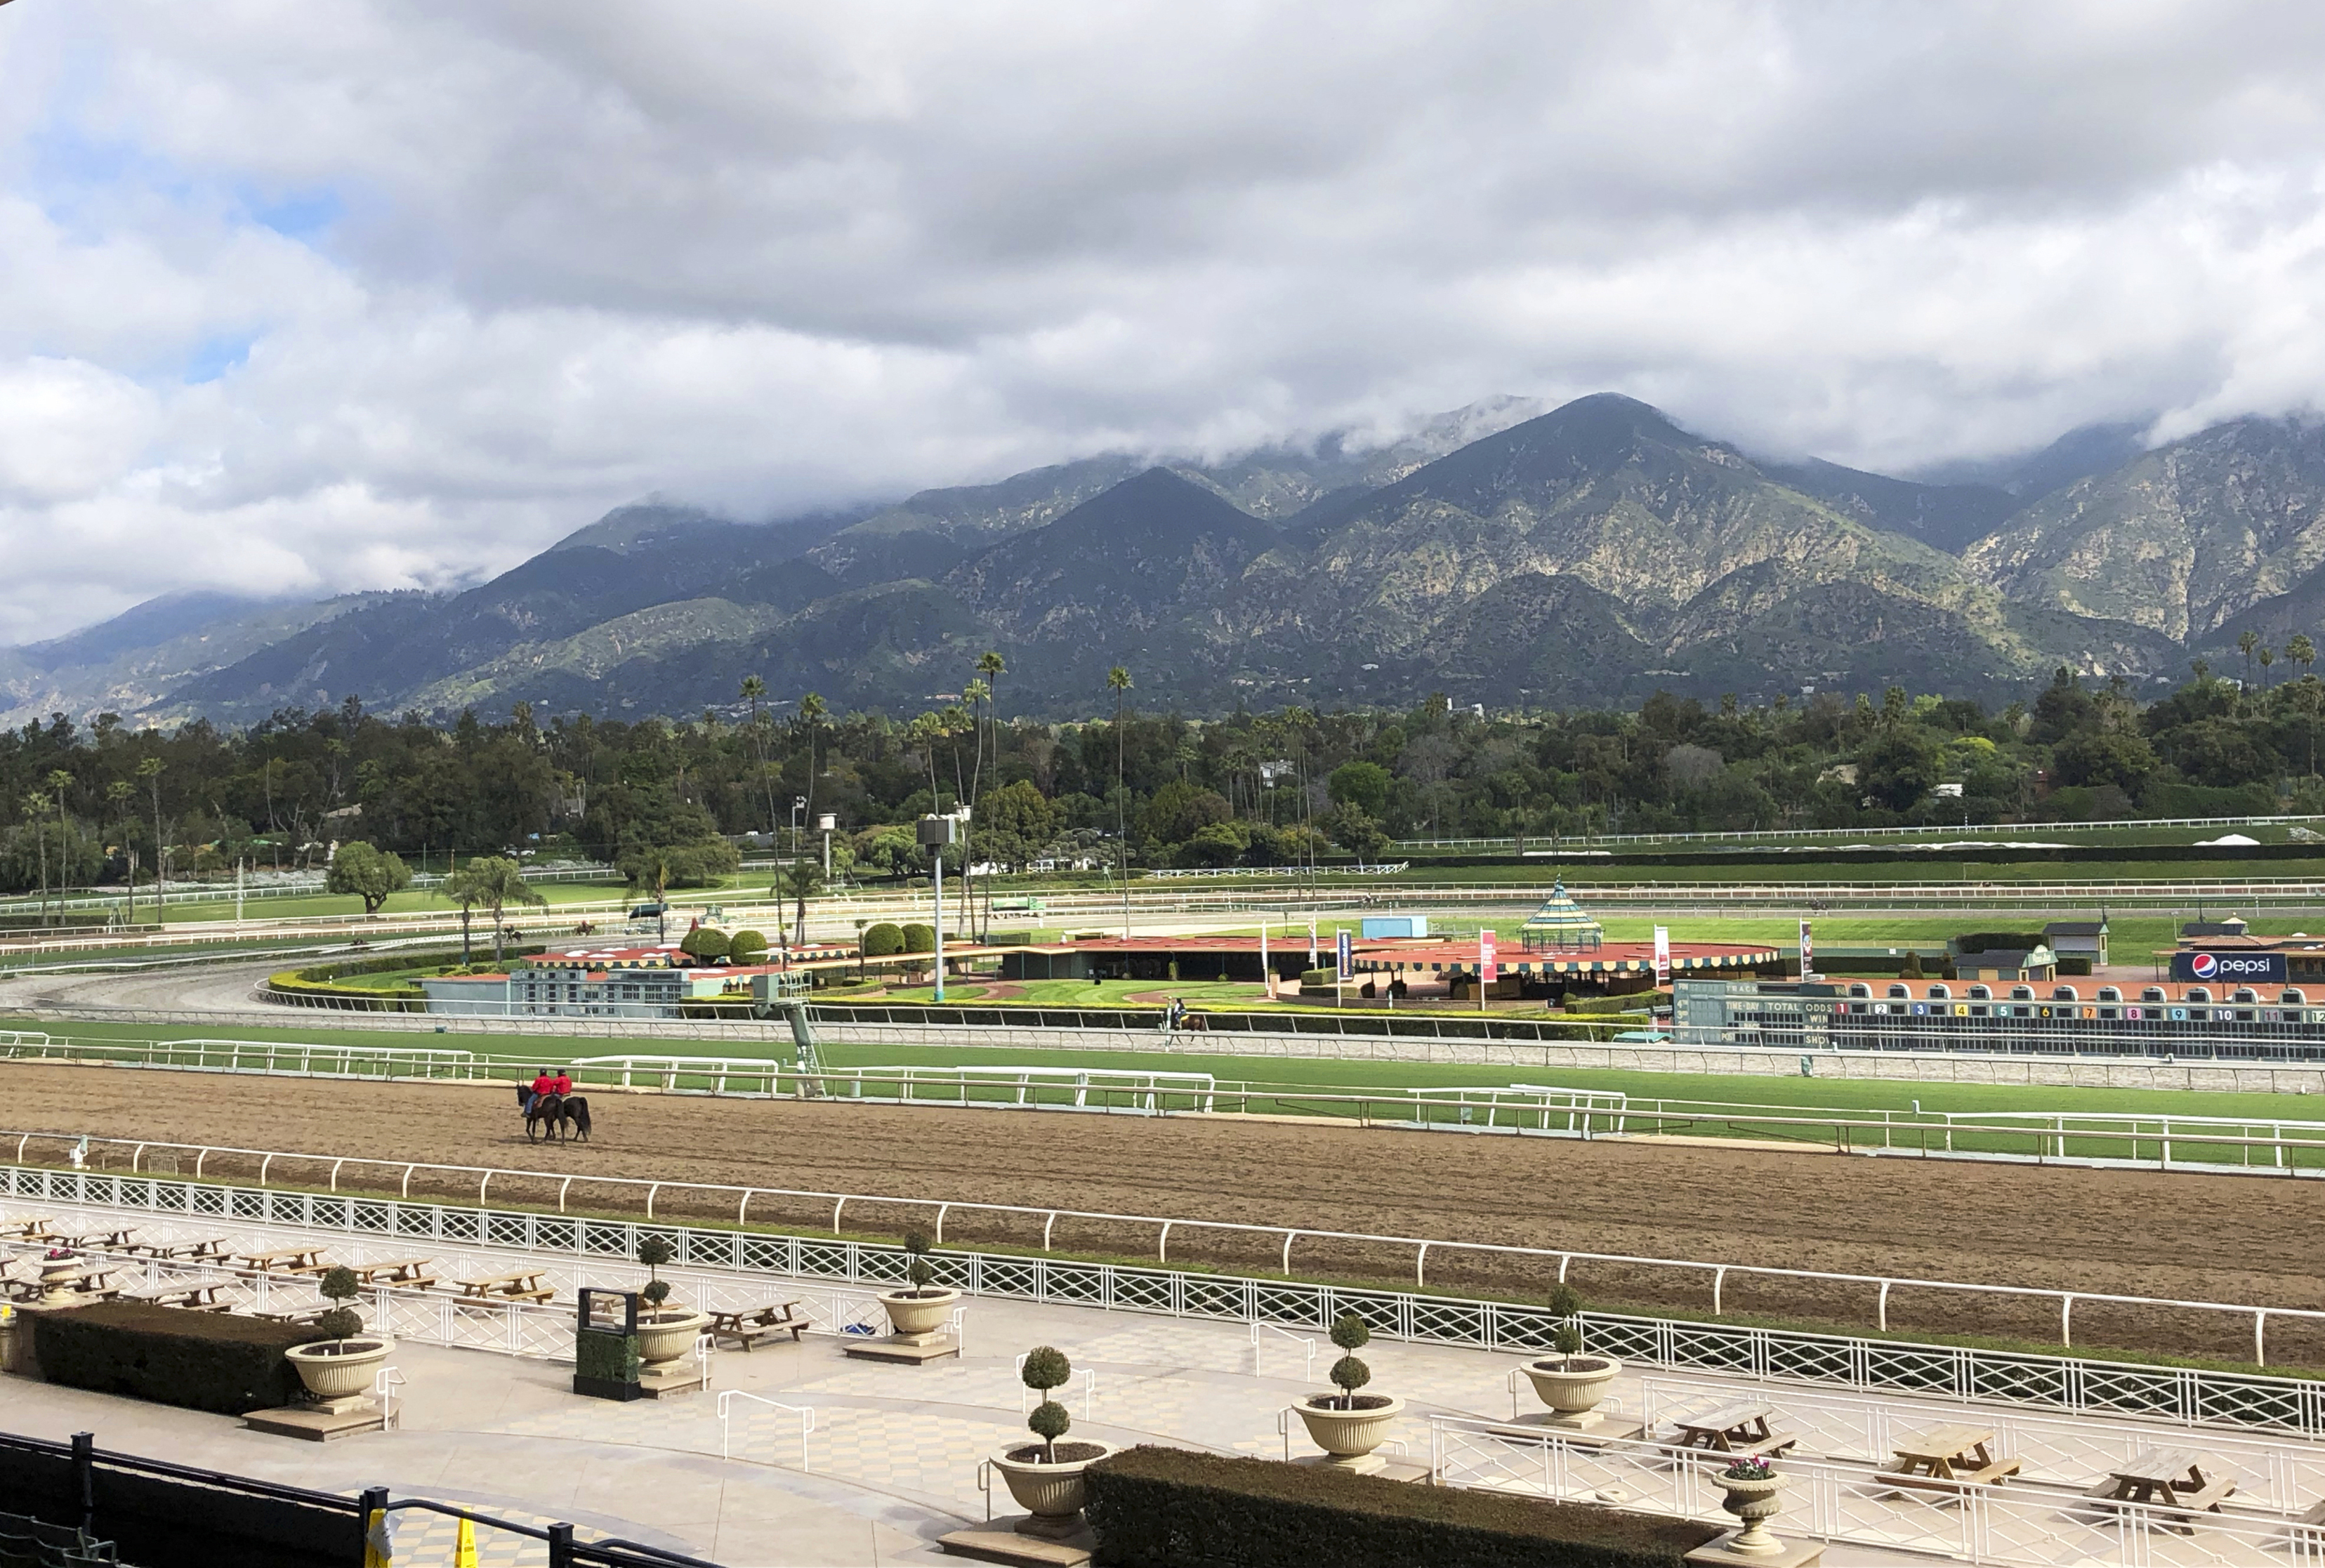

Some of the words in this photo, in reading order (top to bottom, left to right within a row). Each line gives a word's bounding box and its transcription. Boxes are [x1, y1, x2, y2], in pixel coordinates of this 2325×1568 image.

[2220, 958, 2270, 974] pepsi
[1767, 1003, 1799, 1011] TOTAL
[1805, 1003, 1833, 1013] ODDS
[1839, 1004, 1845, 1013] 1
[1878, 1005, 1885, 1015] 2
[1917, 1005, 1925, 1015] 3
[1958, 1006, 1965, 1015] 4
[2000, 1006, 2008, 1017] 5
[2042, 1006, 2049, 1017] 6
[2086, 1008, 2093, 1018] 7
[2130, 1009, 2138, 1019] 8
[2175, 1010, 2182, 1019] 9
[2218, 1010, 2232, 1020] 10
[2265, 1012, 2277, 1021] 11
[2312, 1012, 2325, 1022] 12
[1810, 1014, 1828, 1023] WIN
